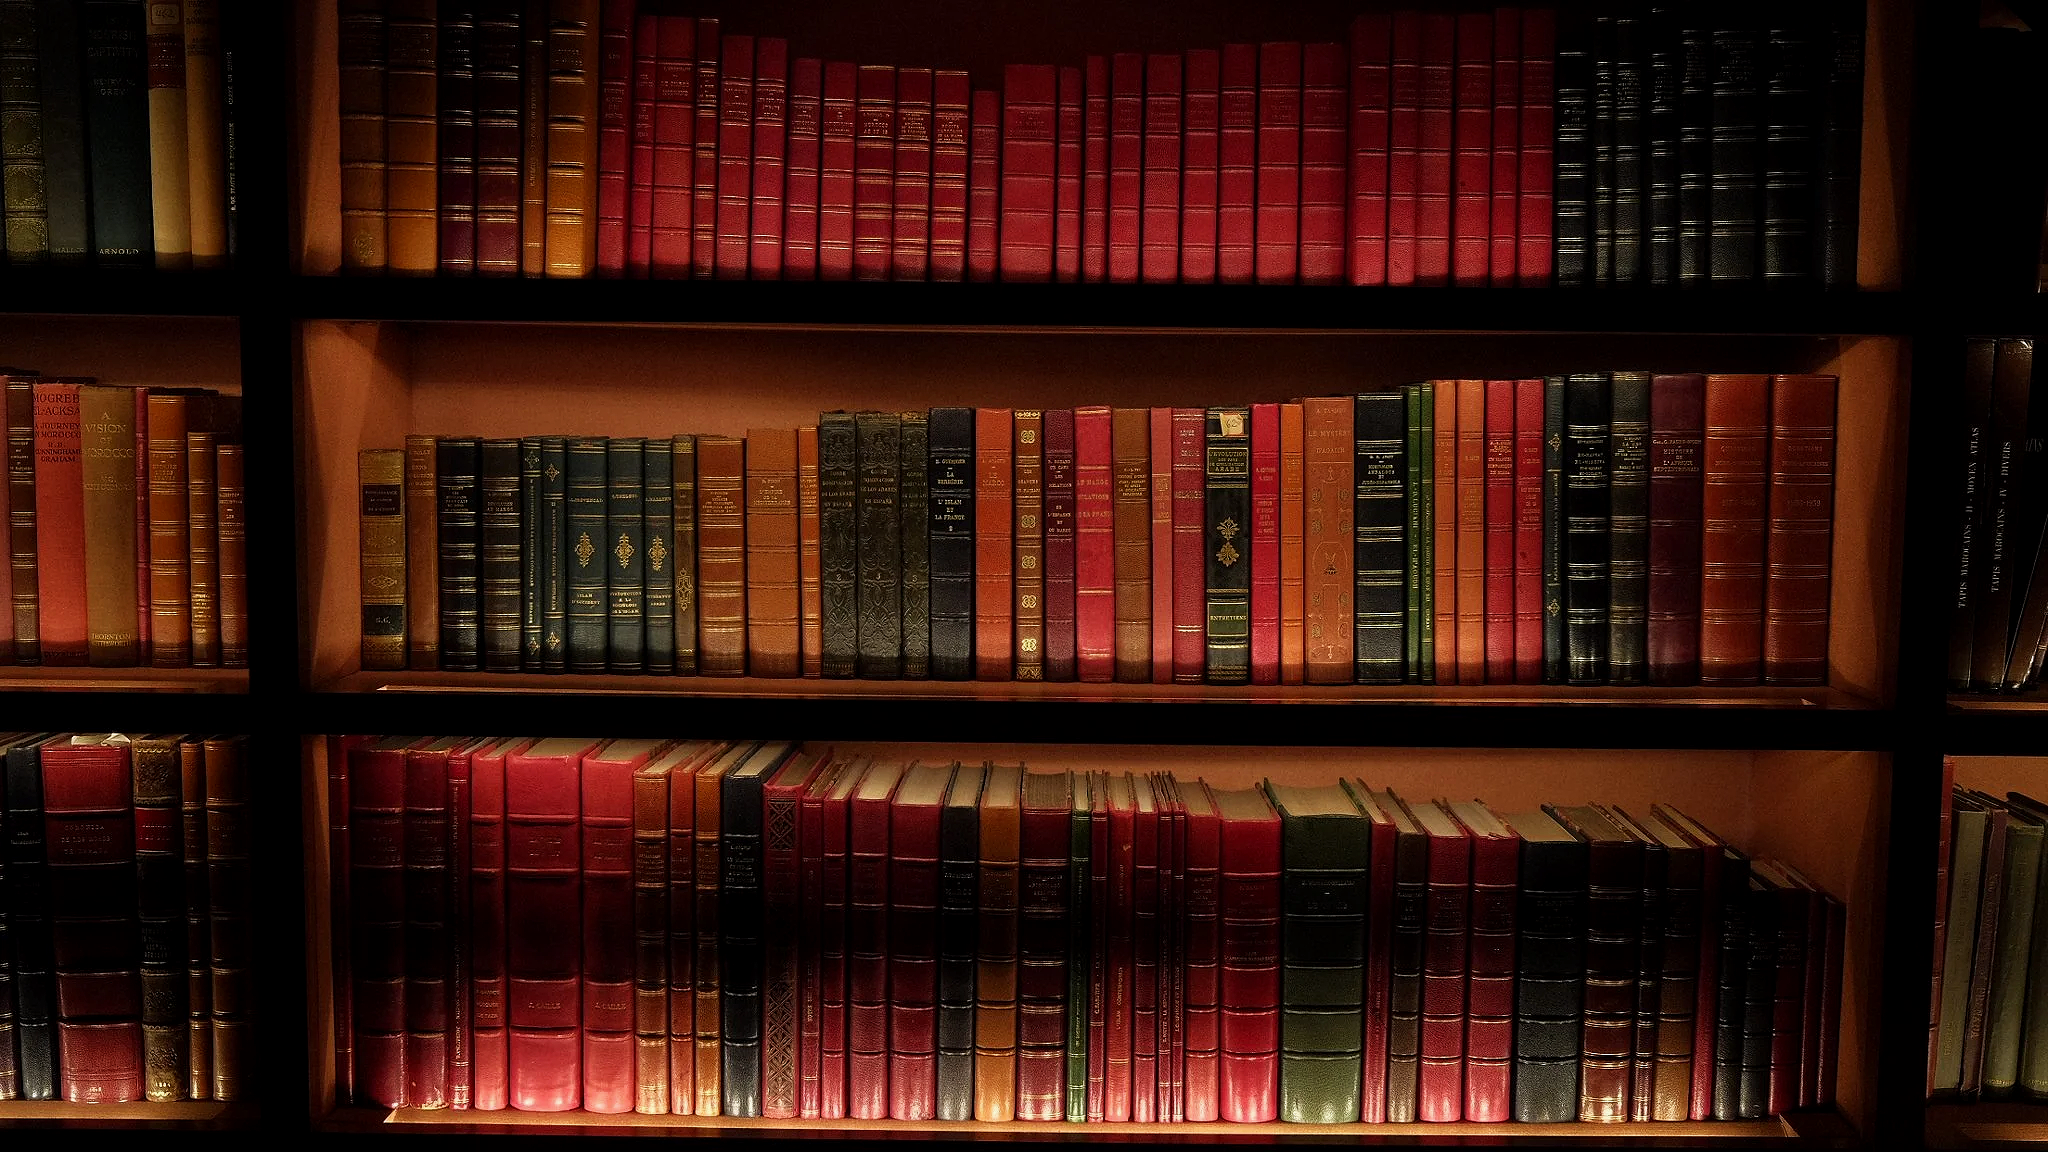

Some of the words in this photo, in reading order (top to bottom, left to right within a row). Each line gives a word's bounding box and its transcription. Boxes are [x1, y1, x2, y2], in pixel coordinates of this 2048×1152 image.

[85, 424, 127, 433] VISION
[102, 412, 110, 420] A
[1969, 426, 1980, 455] ATLAS
[2000, 441, 2011, 476] DIVERS
[1966, 461, 1977, 494] MOYEN
[1993, 508, 2005, 560] MAROCAINS
[1960, 524, 1972, 576] MAROCAINS
[1990, 565, 2001, 593] TAPIS
[1958, 581, 1968, 609] TAPIS
